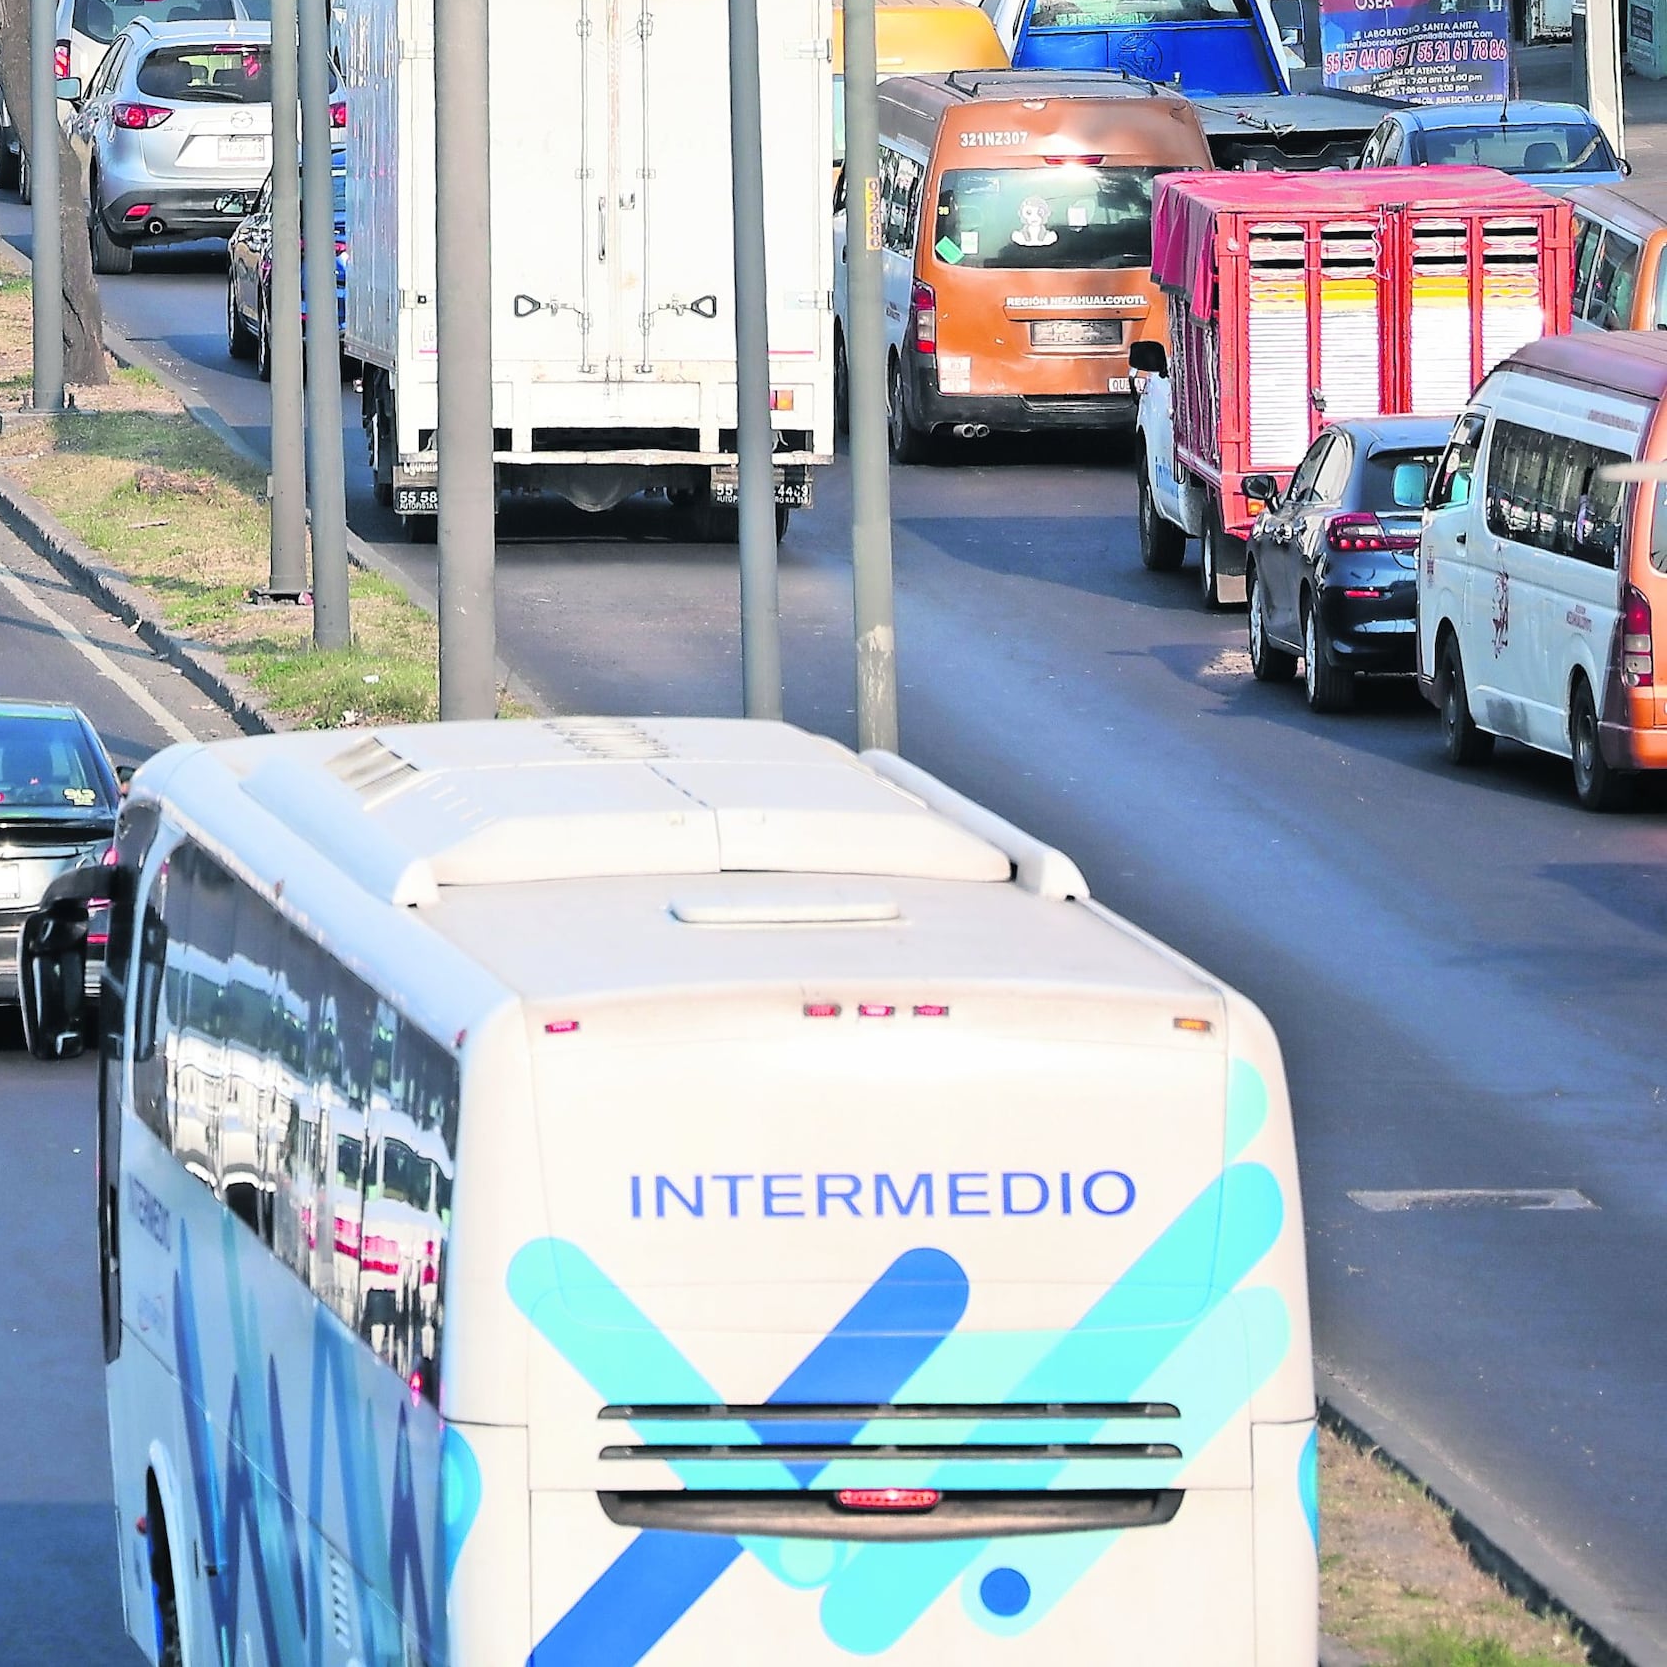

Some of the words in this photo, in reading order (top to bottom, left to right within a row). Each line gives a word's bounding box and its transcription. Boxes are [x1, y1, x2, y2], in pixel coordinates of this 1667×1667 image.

[1422, 21, 1450, 32] SANTA
[1452, 20, 1479, 30] ANITA
[1324, 51, 1341, 75] 55
[1342, 50, 1357, 73] 57
[1359, 49, 1377, 71] 44
[1378, 47, 1394, 69] 00
[1394, 45, 1409, 67] 57
[1417, 41, 1433, 62] 55
[1435, 40, 1450, 61] 21
[1453, 40, 1467, 61] 61
[1472, 39, 1488, 60] 78
[1489, 38, 1508, 60] 86
[1416, 64, 1457, 76] ATENCIÓN
[1468, 73, 1483, 83] pm
[960, 132, 1028, 147] 321NZ307
[1006, 296, 1047, 306] REGIÓN
[1050, 295, 1147, 306] NEZAHUALCOYOTL
[399, 491, 418, 503] 55
[629, 1169, 1137, 1219] INTERMEDIO
